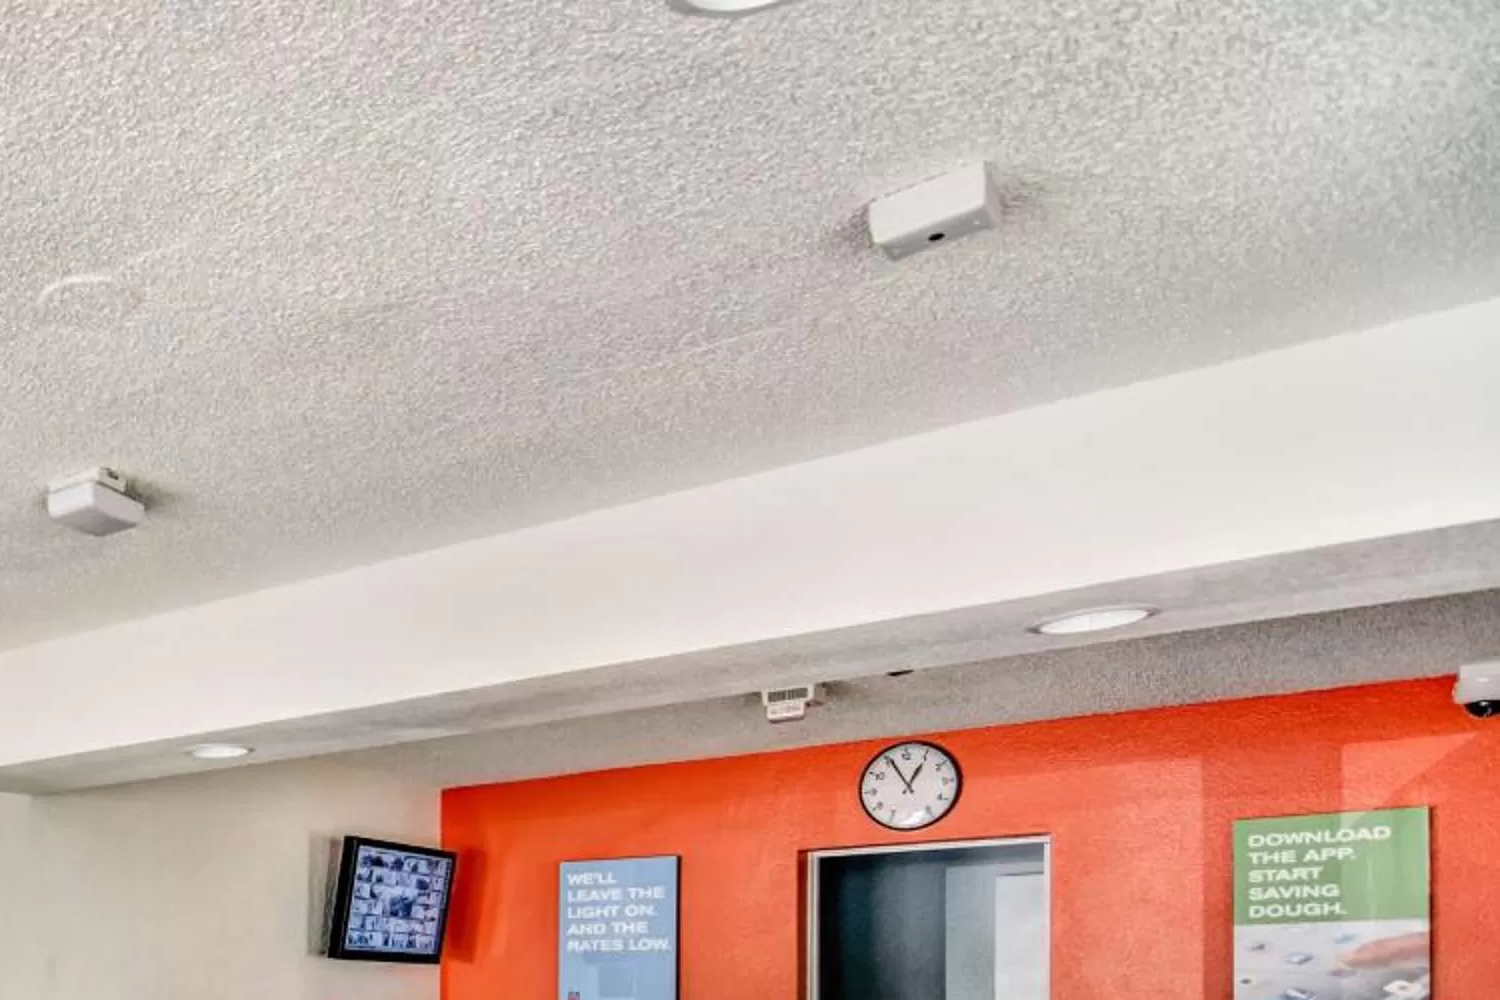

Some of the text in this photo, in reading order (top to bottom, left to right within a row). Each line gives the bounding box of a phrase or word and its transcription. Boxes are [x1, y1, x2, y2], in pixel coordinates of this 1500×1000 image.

[1247, 825, 1393, 848] DOWNLOAD
[1247, 847, 1357, 866] THE APP.
[567, 872, 617, 886] WE'LL
[1248, 867, 1324, 884] START
[568, 886, 666, 903] LEAVE THE
[1248, 883, 1341, 901] SAVING
[568, 906, 621, 920] LIGHT
[1248, 901, 1349, 919] DOUGH.
[567, 921, 650, 936] AND THE
[567, 939, 625, 953] RATES
